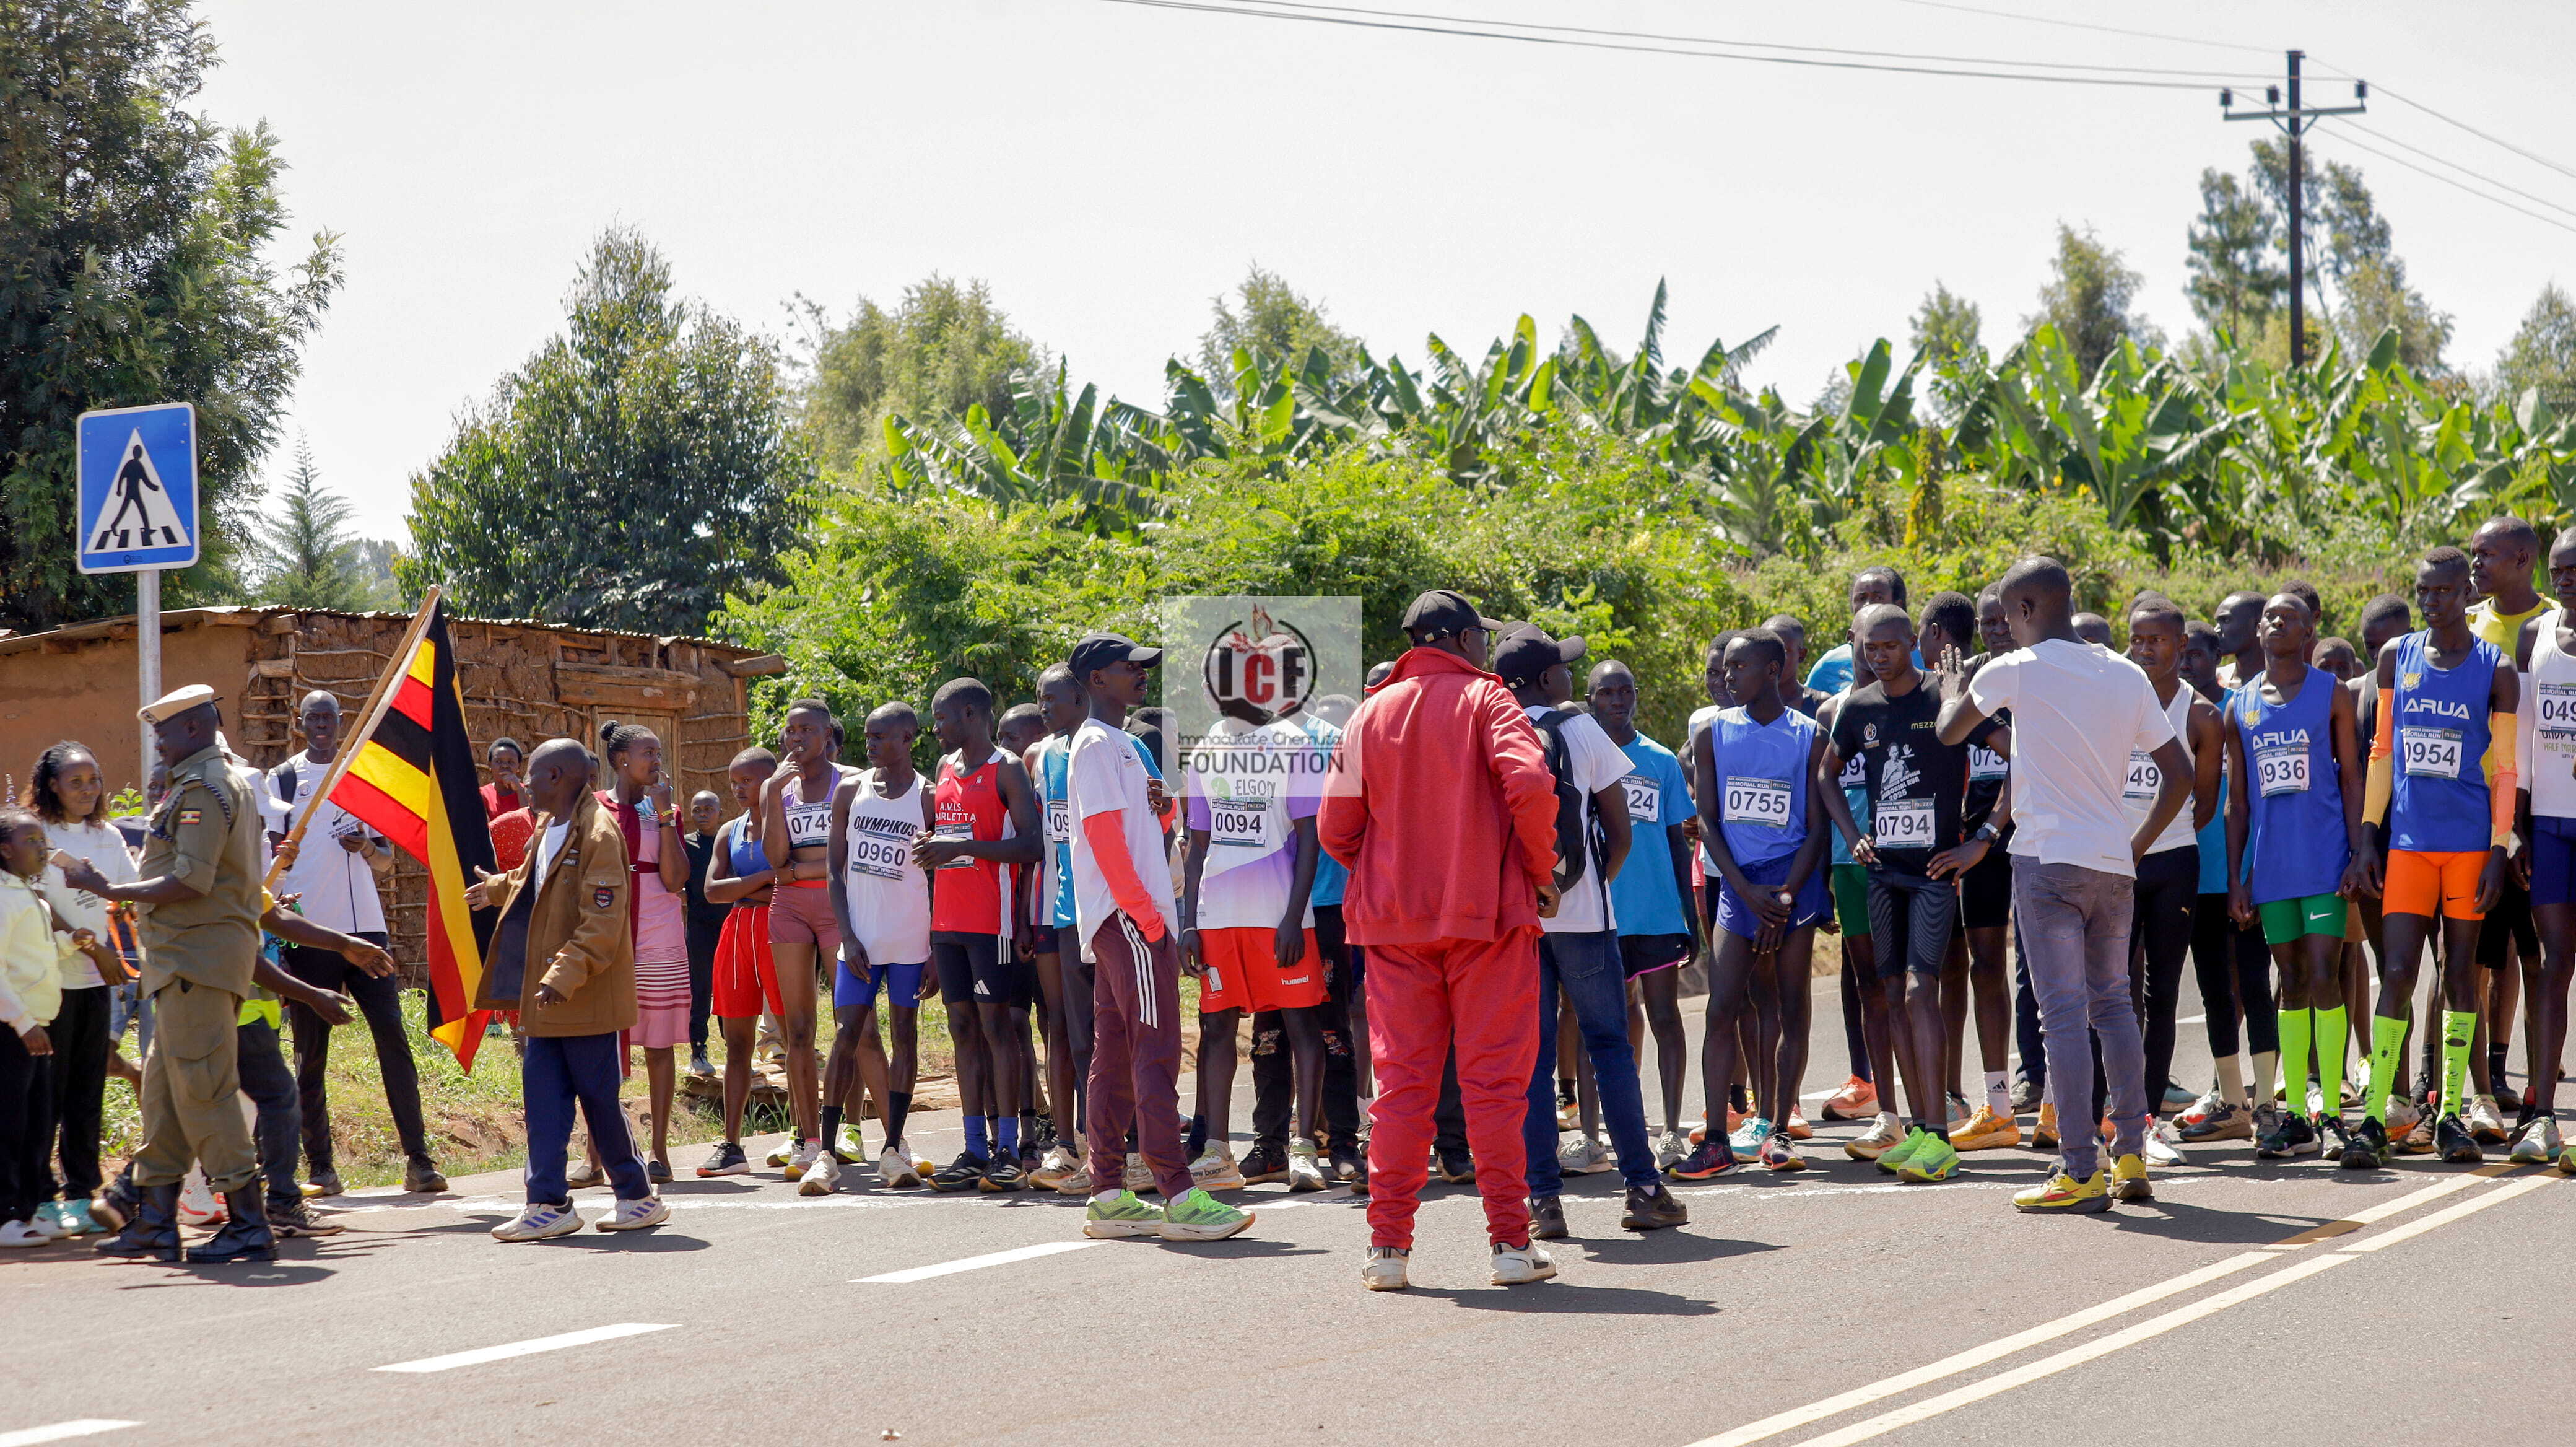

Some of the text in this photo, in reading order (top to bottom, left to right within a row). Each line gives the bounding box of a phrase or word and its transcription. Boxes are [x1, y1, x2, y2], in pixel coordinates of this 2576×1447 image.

[2403, 697, 2470, 720] ARUA
[2543, 699, 2576, 722] 049
[2253, 728, 2310, 750] ARUA
[1973, 748, 2005, 767] 075
[2406, 742, 2456, 766] 0954
[1907, 776, 1920, 785] RUN
[2130, 766, 2159, 787] 49
[2259, 759, 2305, 785] 0936
[1629, 789, 1654, 811] 24
[1730, 790, 1785, 814] 0755
[1889, 789, 1907, 801] 2025
[940, 802, 964, 811] A.V.I.S.
[854, 816, 918, 837] OLYMPIKUS
[1054, 813, 1069, 833] 09
[1216, 812, 1262, 833] 0094
[1879, 814, 1930, 836] 0794
[858, 841, 905, 866] 0960
[1281, 975, 1310, 985] hummel
[1204, 1165, 1230, 1176] balance
